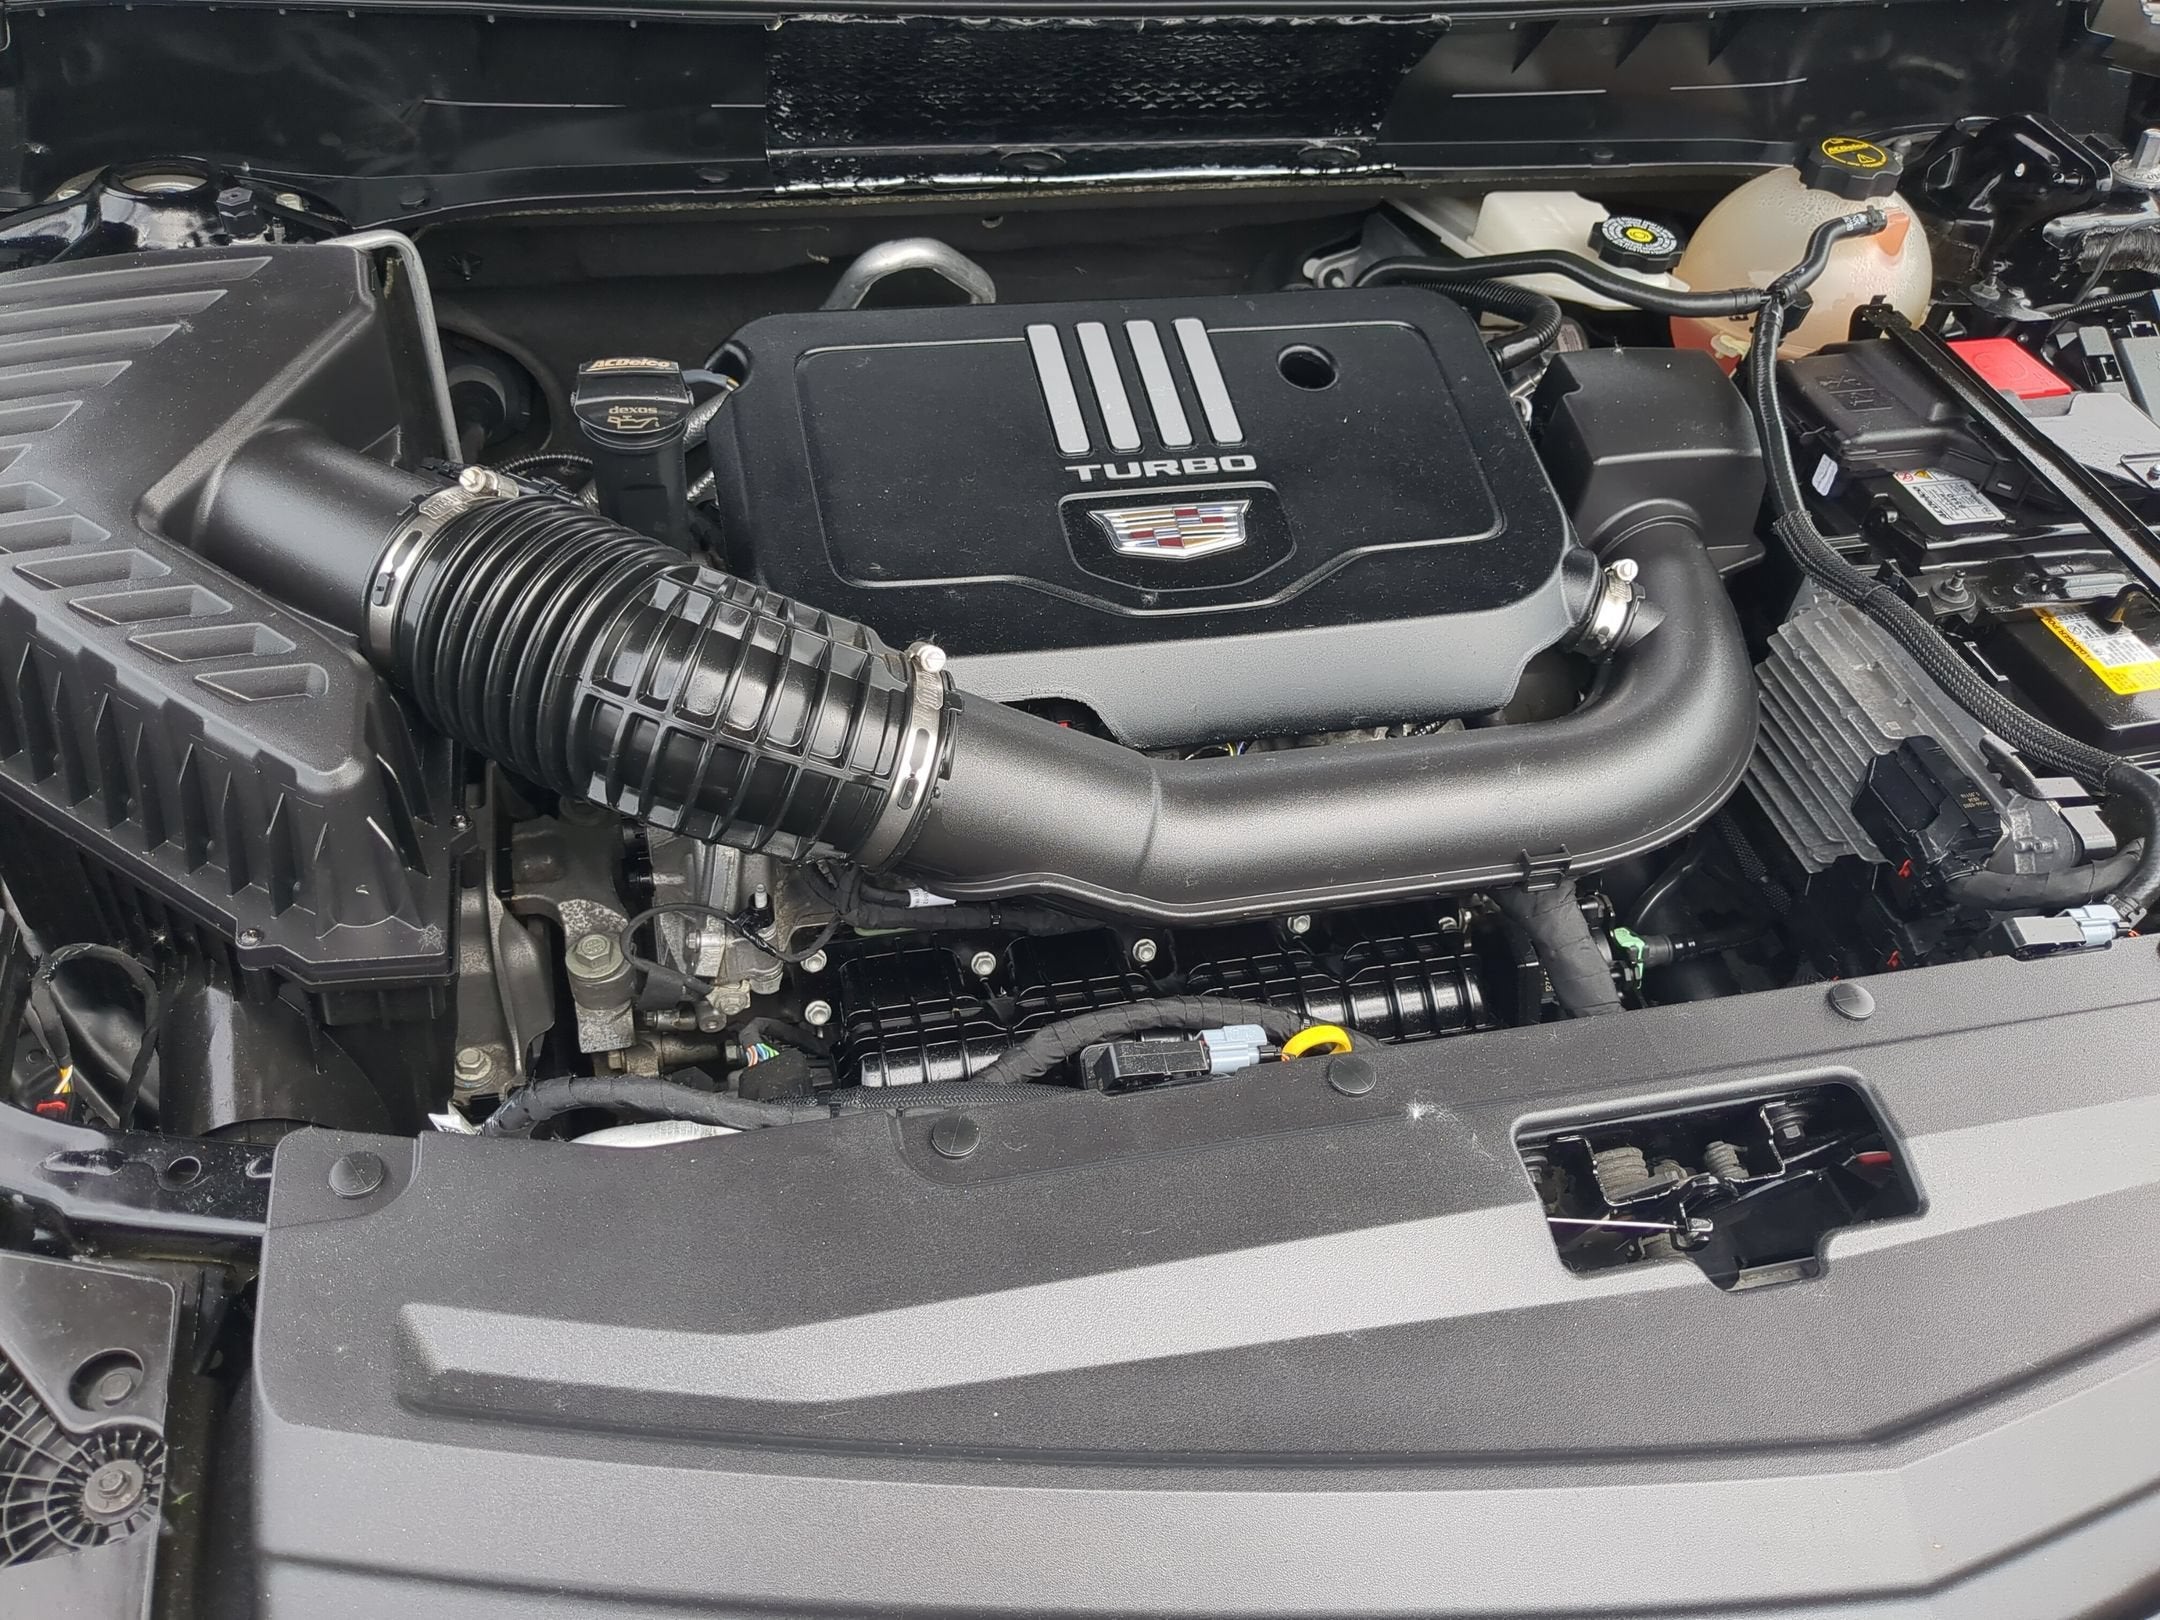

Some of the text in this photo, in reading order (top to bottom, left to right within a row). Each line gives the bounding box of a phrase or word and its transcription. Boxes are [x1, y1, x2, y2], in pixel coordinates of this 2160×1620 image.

[588, 358, 671, 370] ACDelco
[608, 405, 658, 415] dexos
[1065, 454, 1257, 482] TURBO
[2059, 629, 2087, 656] DANGER
